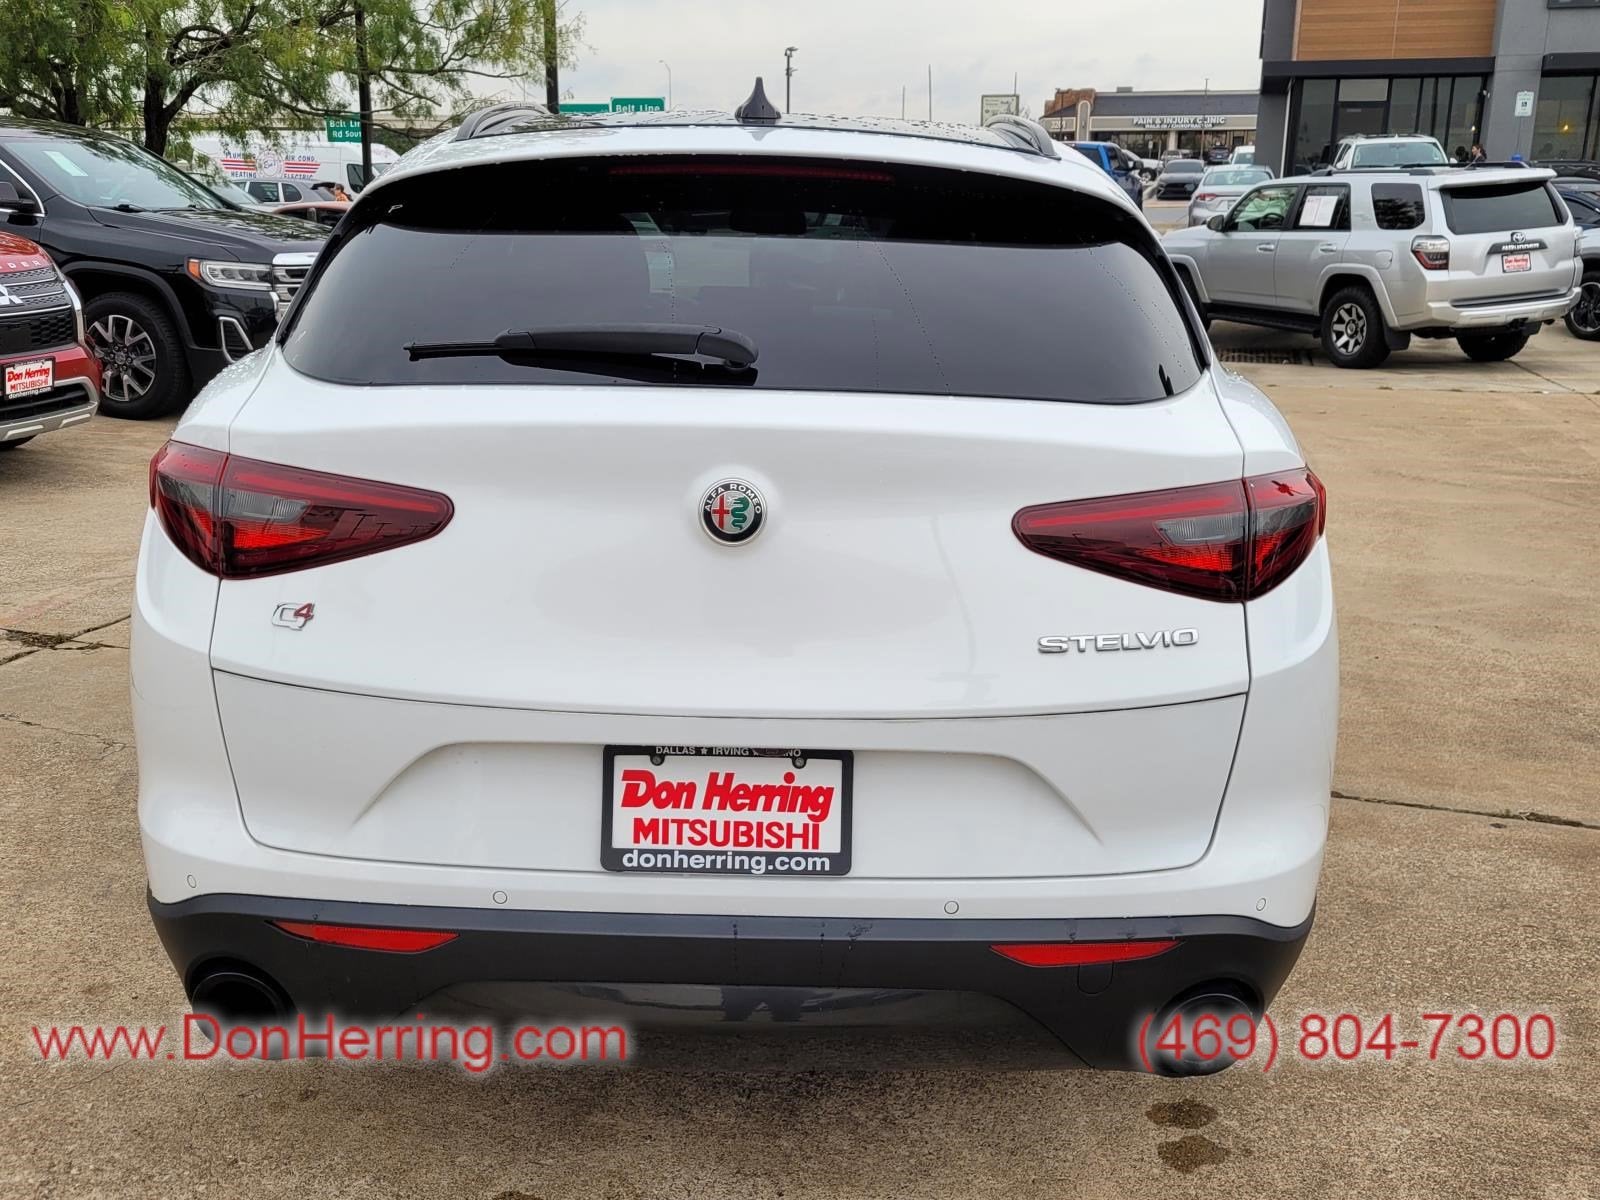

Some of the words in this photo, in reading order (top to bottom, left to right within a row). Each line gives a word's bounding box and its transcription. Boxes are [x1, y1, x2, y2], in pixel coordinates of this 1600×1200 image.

[329, 120, 347, 128] Belt
[350, 120, 361, 128] Lin
[1133, 116, 1153, 124] PAIN
[1155, 116, 1162, 124] &
[1163, 116, 1194, 124] INJURY
[333, 130, 343, 138] Rd
[345, 130, 362, 138] Sout
[230, 171, 257, 179] HEATING
[7, 370, 23, 382] Don
[24, 367, 50, 380] Herring
[10, 378, 48, 392] MITSUBISHI
[705, 486, 725, 512] ALFA
[729, 483, 762, 514] ROMEO
[1038, 628, 1200, 654] STELVIO
[655, 746, 696, 755] DALLAS
[712, 747, 749, 756] IRVING
[621, 769, 697, 809] Don
[702, 771, 834, 823] Herring
[632, 817, 820, 850] MITSUBISHI
[622, 850, 830, 875] donherring.com
